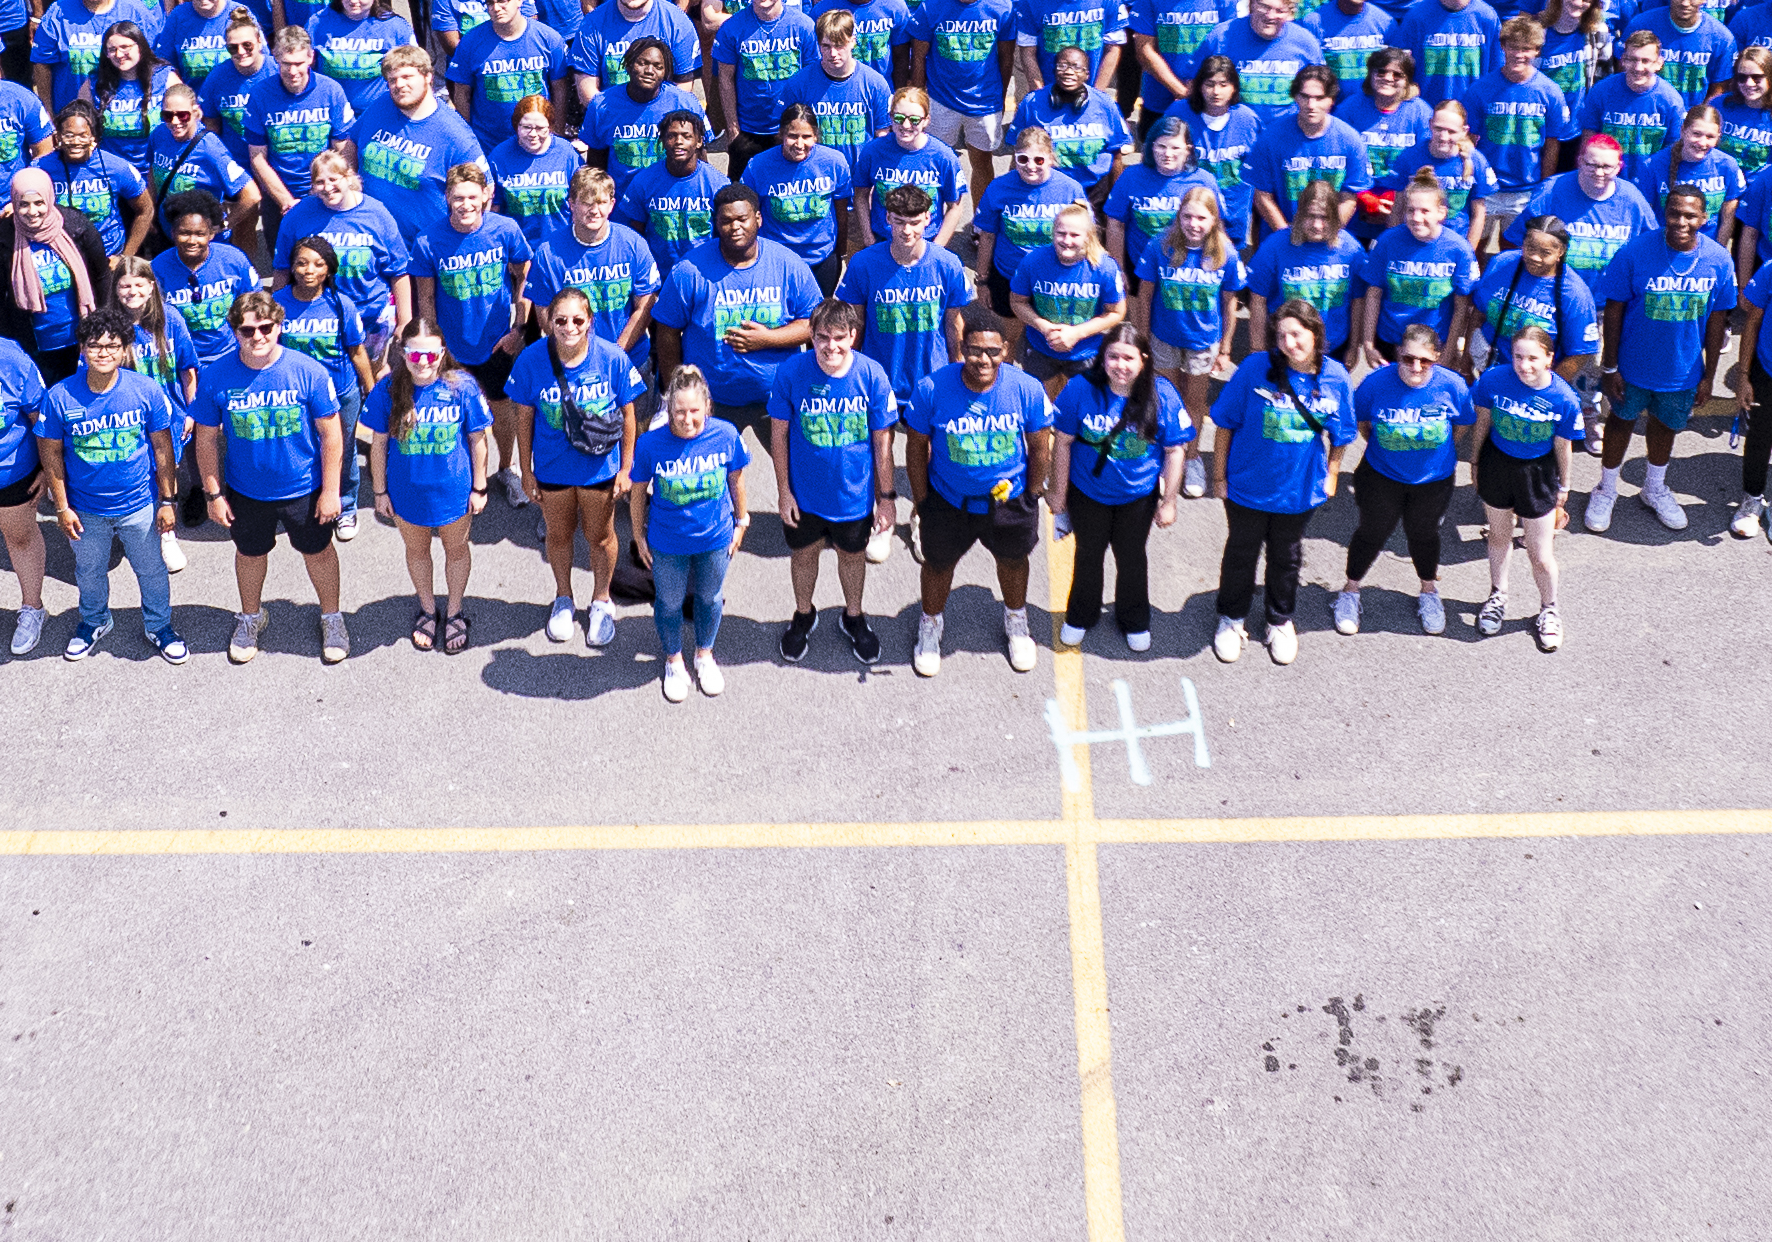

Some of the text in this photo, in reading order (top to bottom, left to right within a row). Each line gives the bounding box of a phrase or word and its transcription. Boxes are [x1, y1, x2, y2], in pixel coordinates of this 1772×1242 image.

[936, 19, 998, 33] ADM/MU
[1042, 9, 1104, 25] ADM/MU
[1157, 11, 1219, 25] ADM/MU
[739, 37, 802, 54] ADM/MU
[482, 56, 546, 74] ADM/MU
[265, 108, 332, 126] ADM/MU
[371, 128, 432, 160] ADM/MU
[365, 141, 427, 179] DAY OF
[504, 170, 566, 187] ADM/MU
[768, 176, 831, 197] ADM/MU
[1565, 221, 1631, 240] ADM/MU
[439, 247, 503, 271] ADM/MU
[563, 263, 631, 285] ADM/MU
[1282, 264, 1349, 283] ADM/MU
[1033, 280, 1100, 297] ADM/MU
[1646, 277, 1717, 292] ADM/MU
[715, 286, 781, 305] ADM/MU
[874, 285, 945, 303] ADM/MU
[228, 389, 299, 411] ADM/MU
[800, 395, 869, 413] ADM/MU
[71, 409, 143, 437] ADM/MU
[408, 405, 460, 423] M/MU
[946, 413, 1019, 434] ADM/MU
[655, 452, 726, 477] ADM/MU
